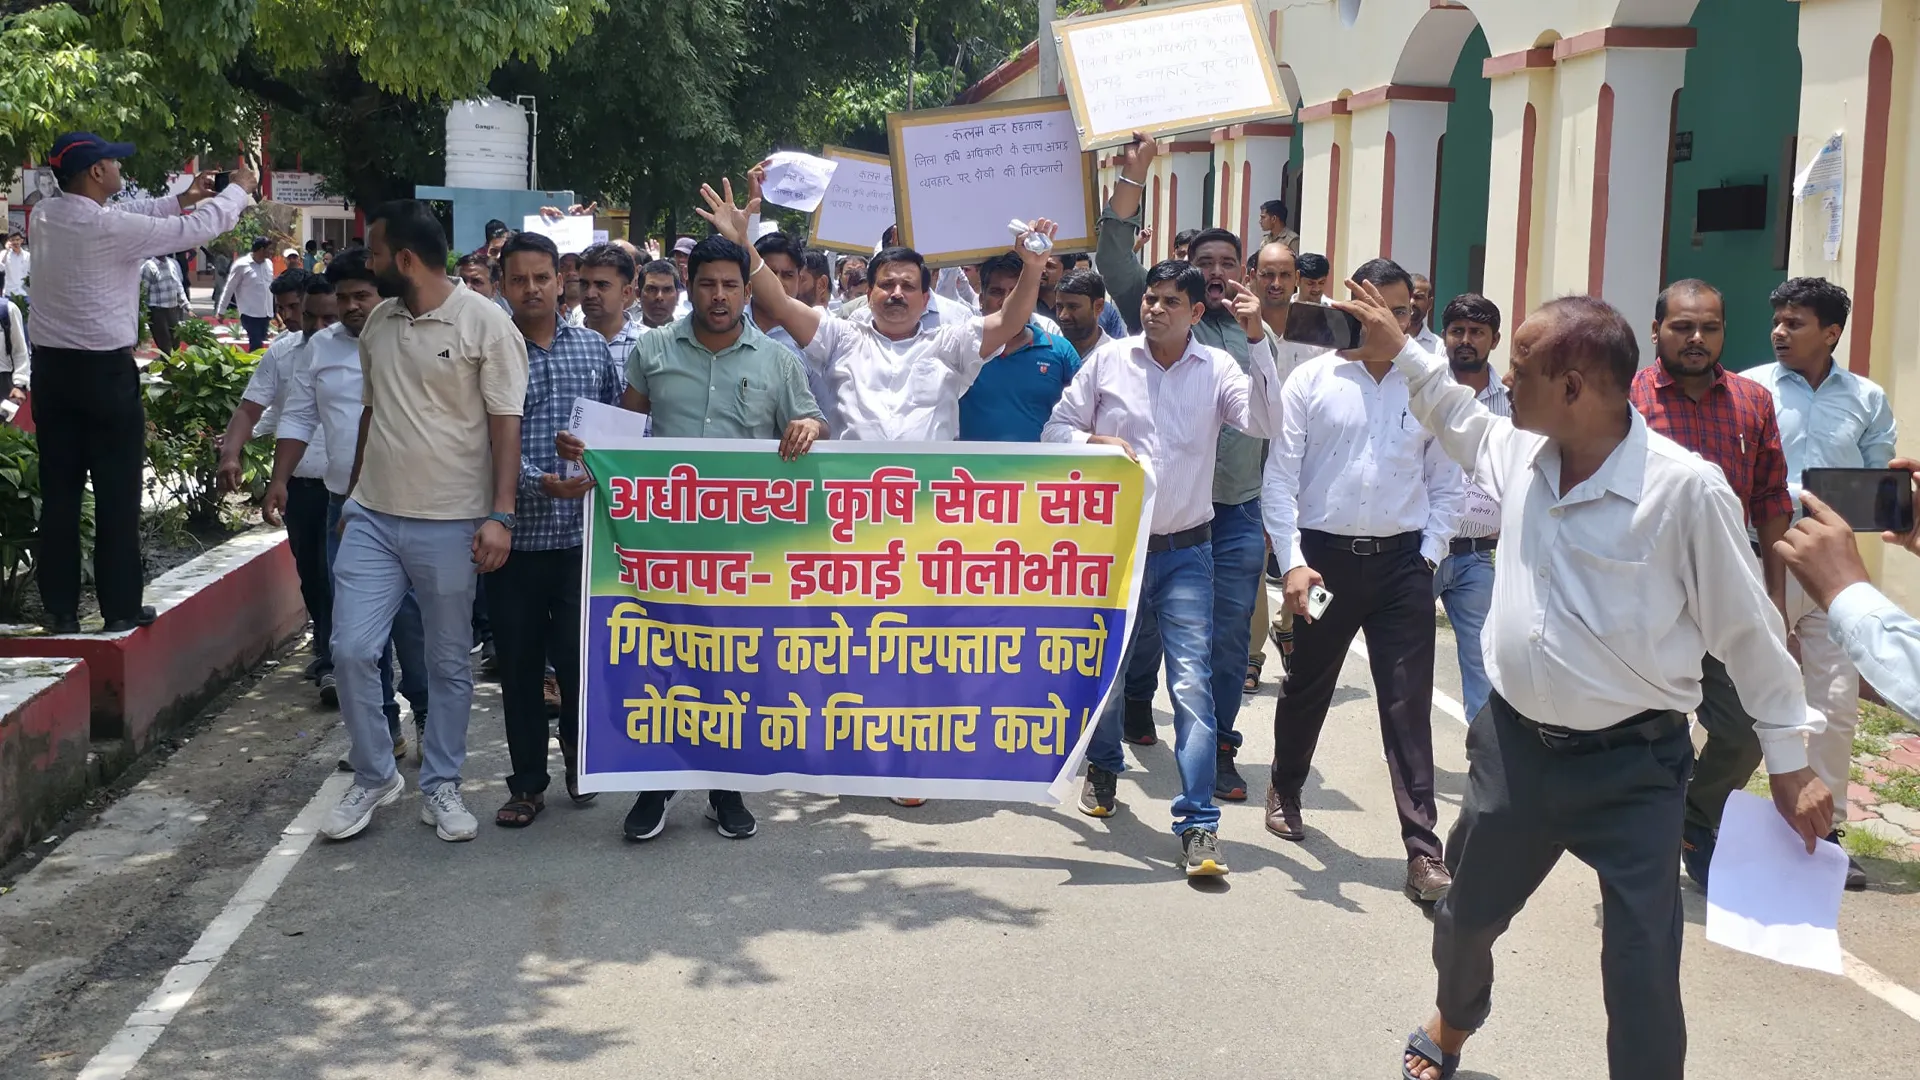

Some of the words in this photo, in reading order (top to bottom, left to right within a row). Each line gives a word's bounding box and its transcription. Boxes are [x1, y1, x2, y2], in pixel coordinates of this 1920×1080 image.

[914, 153, 937, 168] जिला
[965, 144, 1003, 161] अधिकारी
[1009, 142, 1019, 155] के
[1022, 143, 1042, 154] साथ
[952, 126, 985, 142] कलम
[919, 175, 953, 190] व्यवहार
[957, 172, 971, 185] पर
[1003, 164, 1016, 178] की
[573, 406, 584, 429] चलेगी
[610, 464, 813, 524] अधीनस्थ
[825, 466, 920, 543] कृषि
[930, 467, 1026, 525] सेवा
[1037, 469, 1121, 526] संघ
[786, 539, 906, 600] इकाई
[916, 540, 1115, 598] पीलीभीत
[607, 603, 763, 673] गिरफ्तार
[1036, 614, 1108, 677] करो
[624, 684, 750, 749] दोषियों
[757, 693, 811, 751] को
[822, 693, 981, 752] गिरफ्तार
